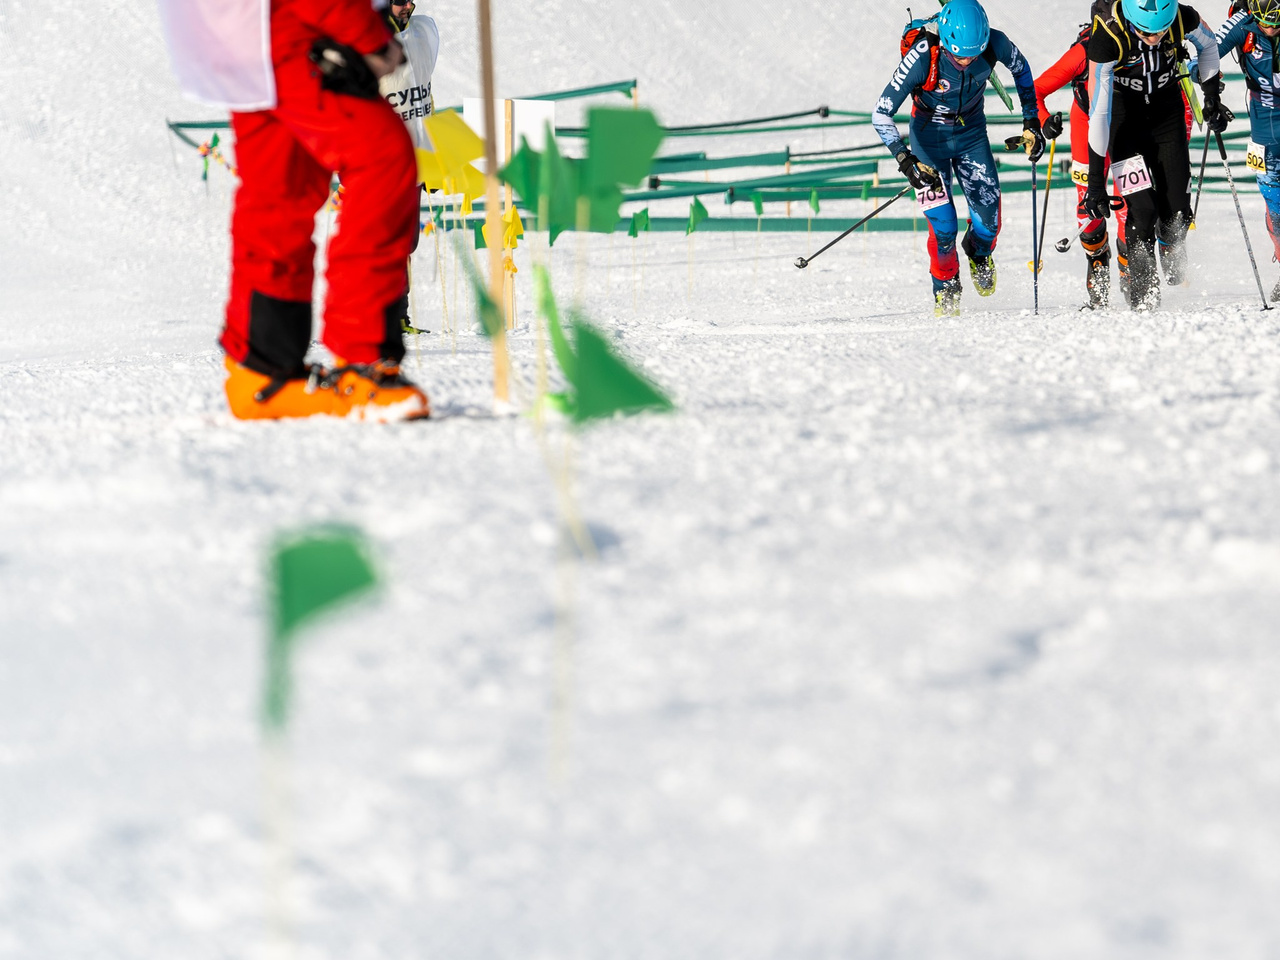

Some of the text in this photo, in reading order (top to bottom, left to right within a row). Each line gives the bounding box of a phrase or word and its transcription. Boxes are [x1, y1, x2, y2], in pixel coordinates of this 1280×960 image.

[891, 40, 929, 92] SKIMO
[1248, 152, 1264, 168] 502
[1073, 170, 1089, 182] 50
[1118, 169, 1147, 188] 701
